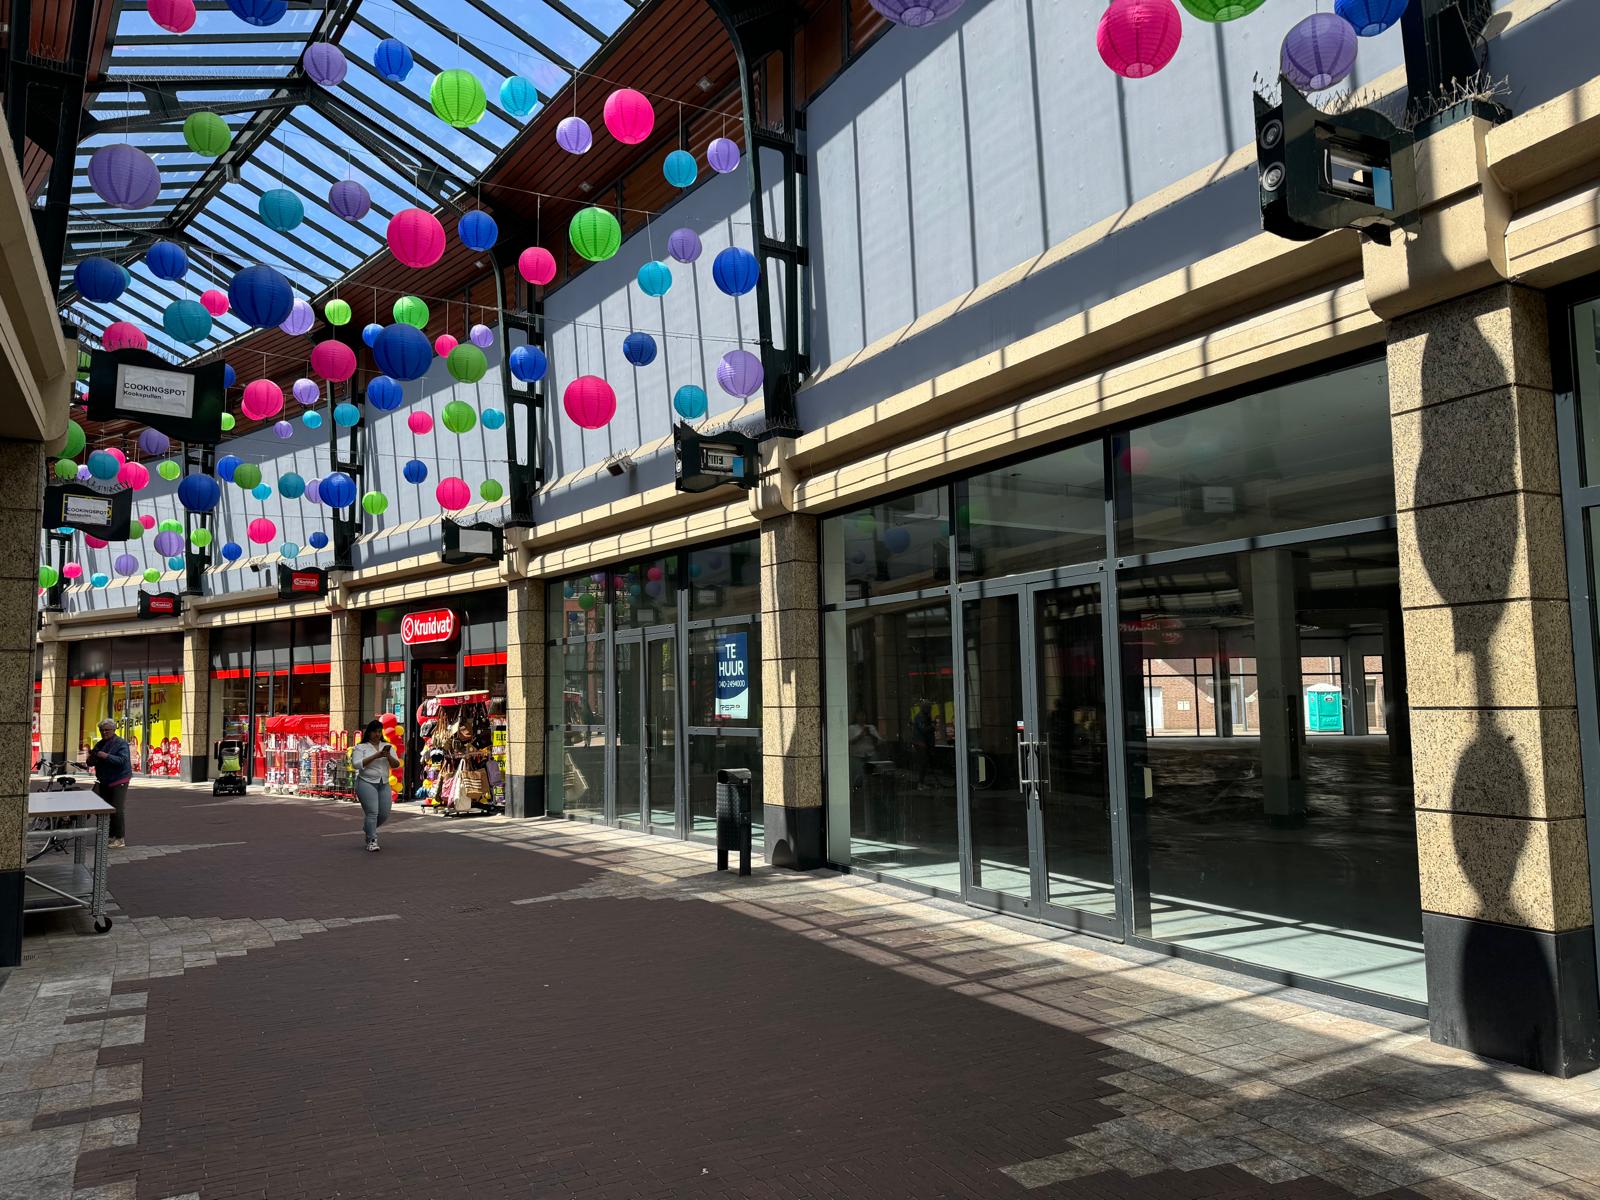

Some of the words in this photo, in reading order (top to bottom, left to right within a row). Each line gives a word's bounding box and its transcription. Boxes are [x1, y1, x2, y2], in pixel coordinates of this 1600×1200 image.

[124, 383, 187, 396] COOKINGSPOT
[414, 616, 450, 636] Kruidvat
[725, 643, 737, 659] TE
[718, 660, 744, 676] HUUR
